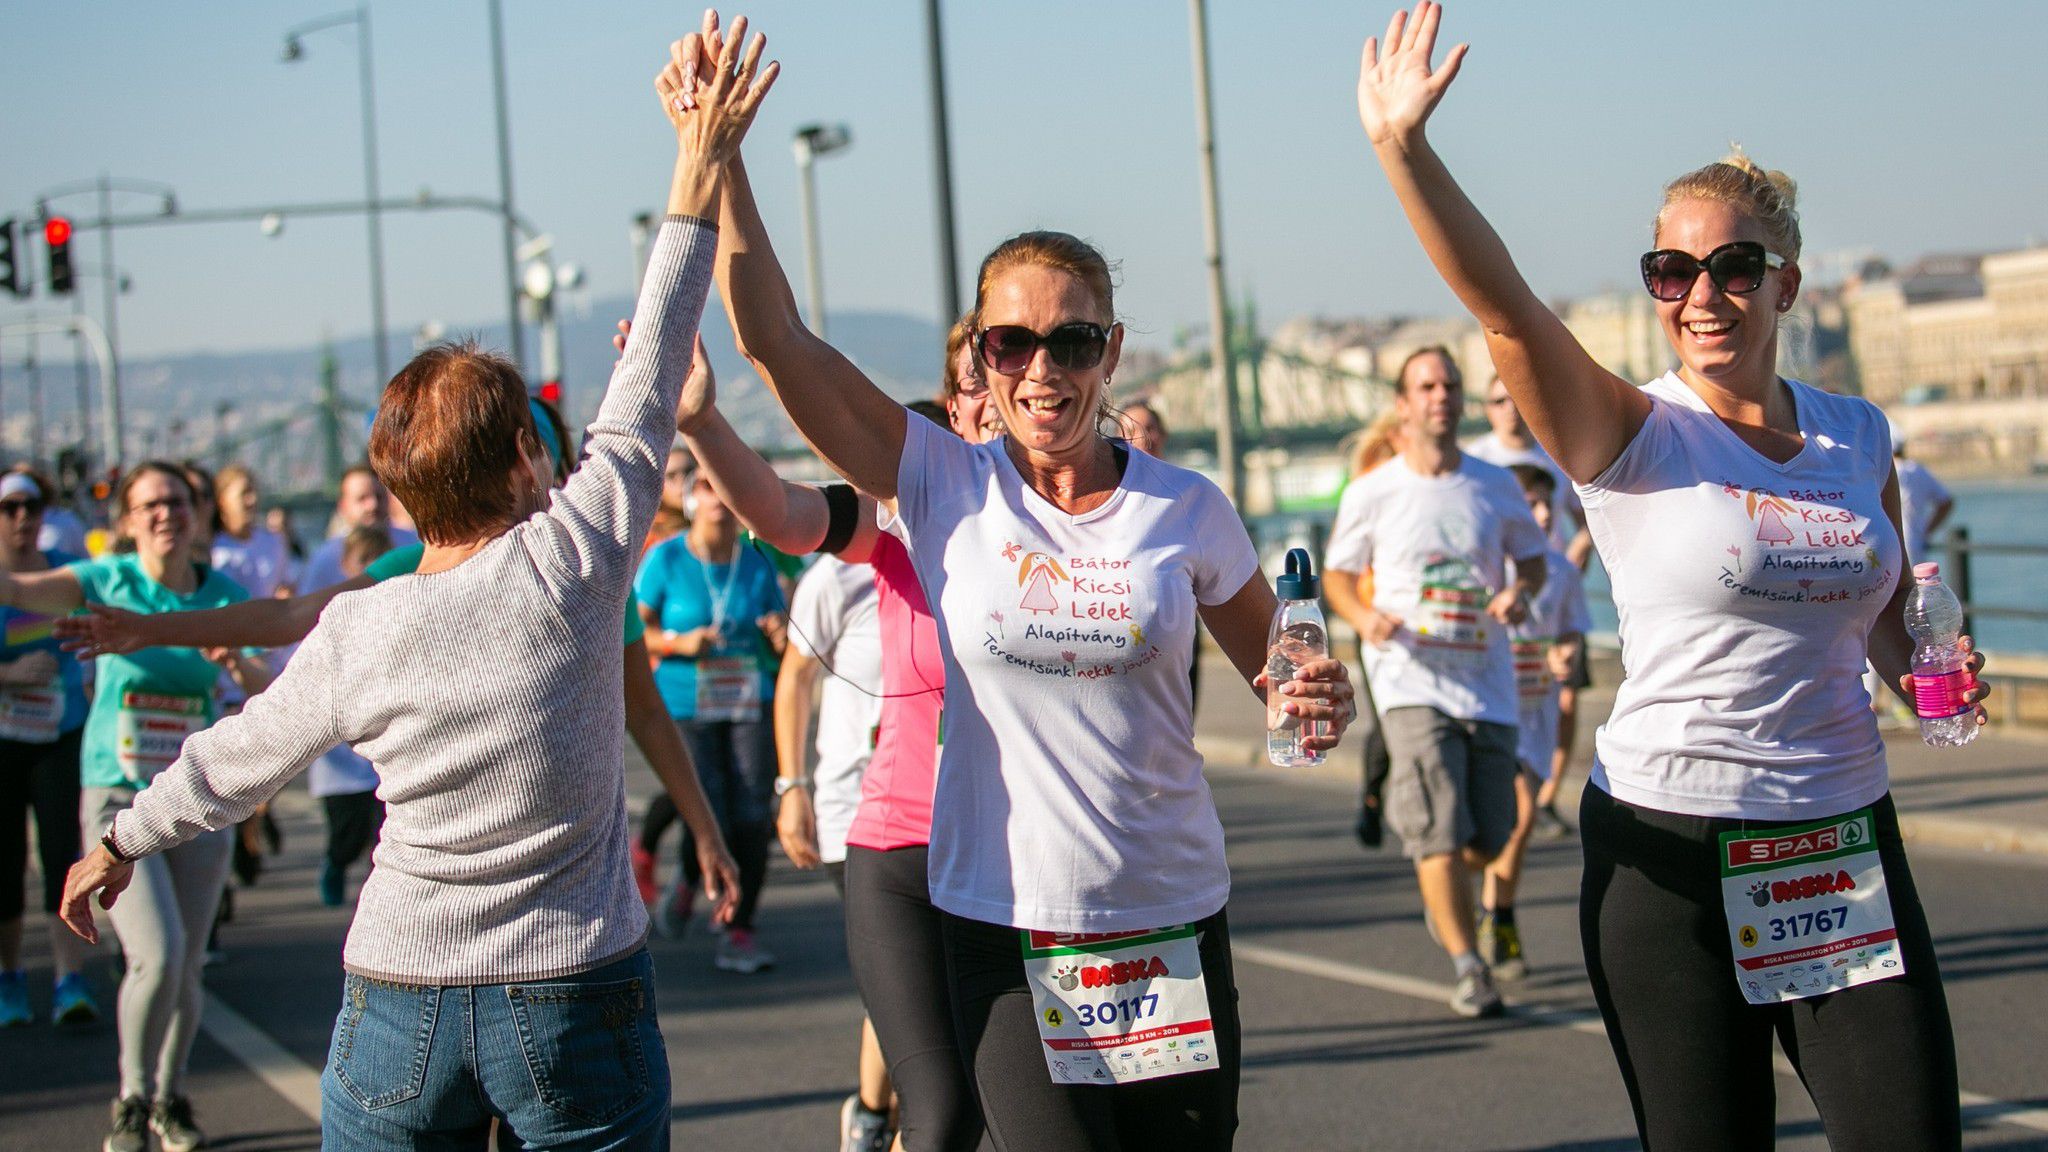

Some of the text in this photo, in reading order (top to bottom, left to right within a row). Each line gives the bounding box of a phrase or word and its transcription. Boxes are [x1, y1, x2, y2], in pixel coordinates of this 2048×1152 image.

[1790, 489, 1846, 501] Bátor
[1800, 508, 1856, 523] Kicsi
[1806, 530, 1865, 547] Lélek
[1070, 555, 1132, 569] Bátor
[1763, 555, 1863, 573] Alapítvány
[1073, 576, 1131, 595] Kicsi
[1717, 566, 1804, 602] Teremtsünk
[1809, 589, 1851, 603] nekik
[1072, 601, 1132, 621] Lélek
[1025, 623, 1126, 648] Alapítvány
[983, 631, 1071, 678] Teremtsünk
[1077, 664, 1116, 679] nekik
[1750, 832, 1834, 859] SPAR
[1771, 870, 1855, 903] RISKA
[1769, 906, 1848, 941] 31767
[1743, 929, 1755, 944] 4
[1763, 956, 1782, 964] RISKA
[1783, 948, 1829, 960] MINIMARATON
[1081, 956, 1169, 988] RISKA
[1048, 1009, 1062, 1026] 4
[1077, 993, 1159, 1027] 30117
[1091, 1035, 1139, 1047] MINIMARATON
